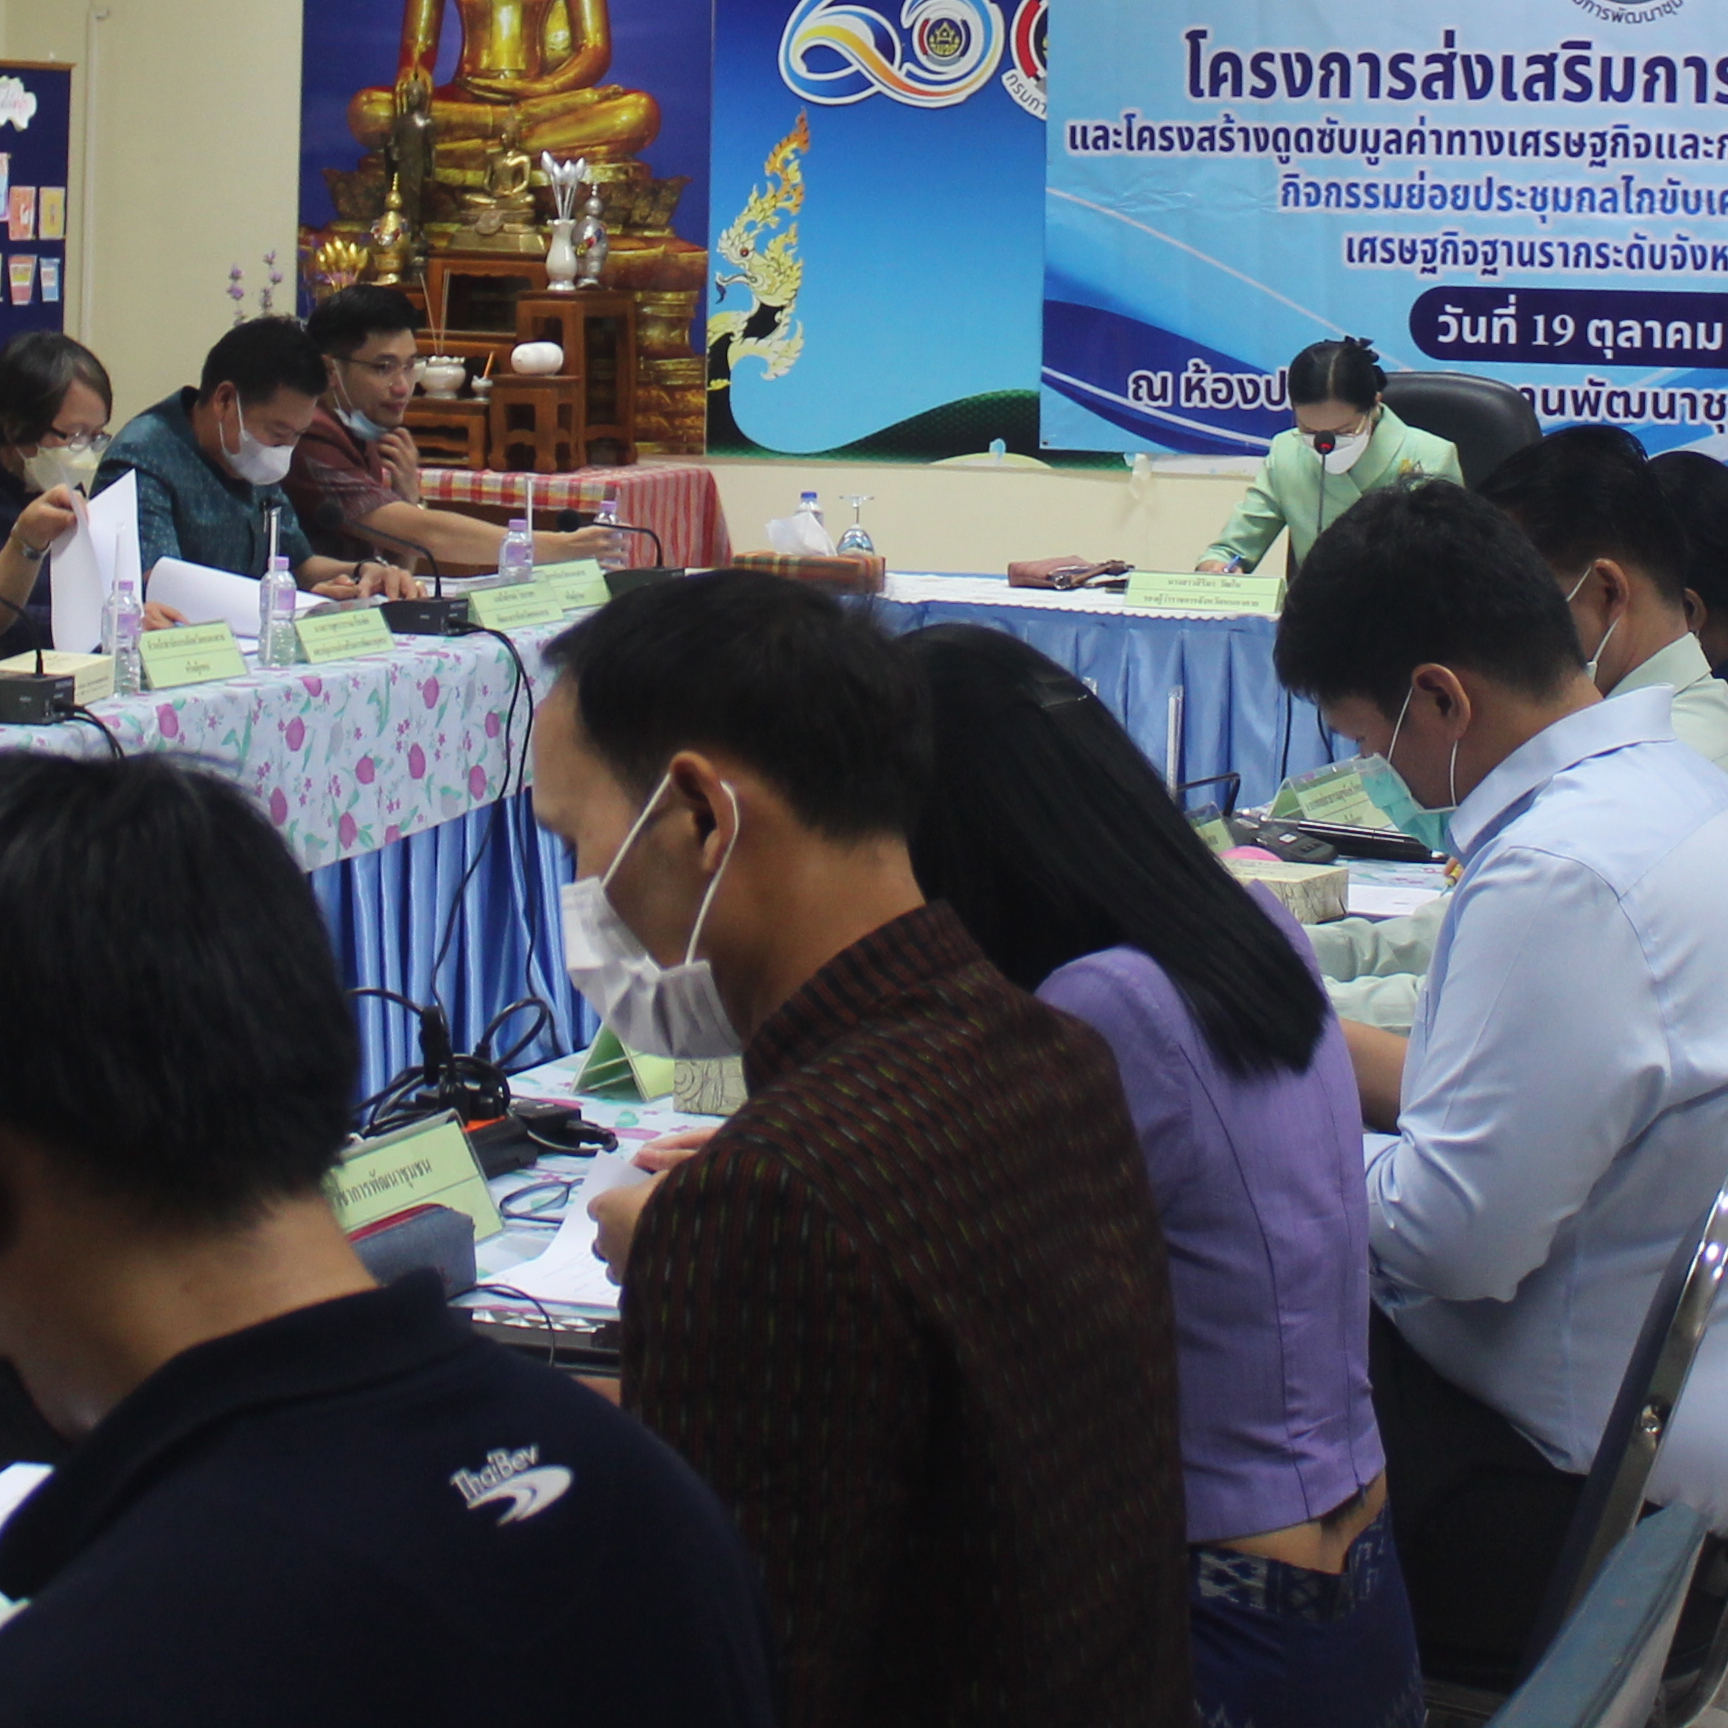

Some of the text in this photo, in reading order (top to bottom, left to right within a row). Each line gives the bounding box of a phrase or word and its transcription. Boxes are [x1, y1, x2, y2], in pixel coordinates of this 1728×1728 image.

[1437, 294, 1518, 347] วันที่
[1532, 314, 1574, 347] 19
[1586, 318, 1723, 359] ตุลาคม
[1131, 373, 1168, 403] ณ
[1184, 360, 1288, 408] ห้องป
[335, 1157, 434, 1208] ชาการพัฒนาชุมชน
[449, 1443, 540, 1501] ThaiBev
